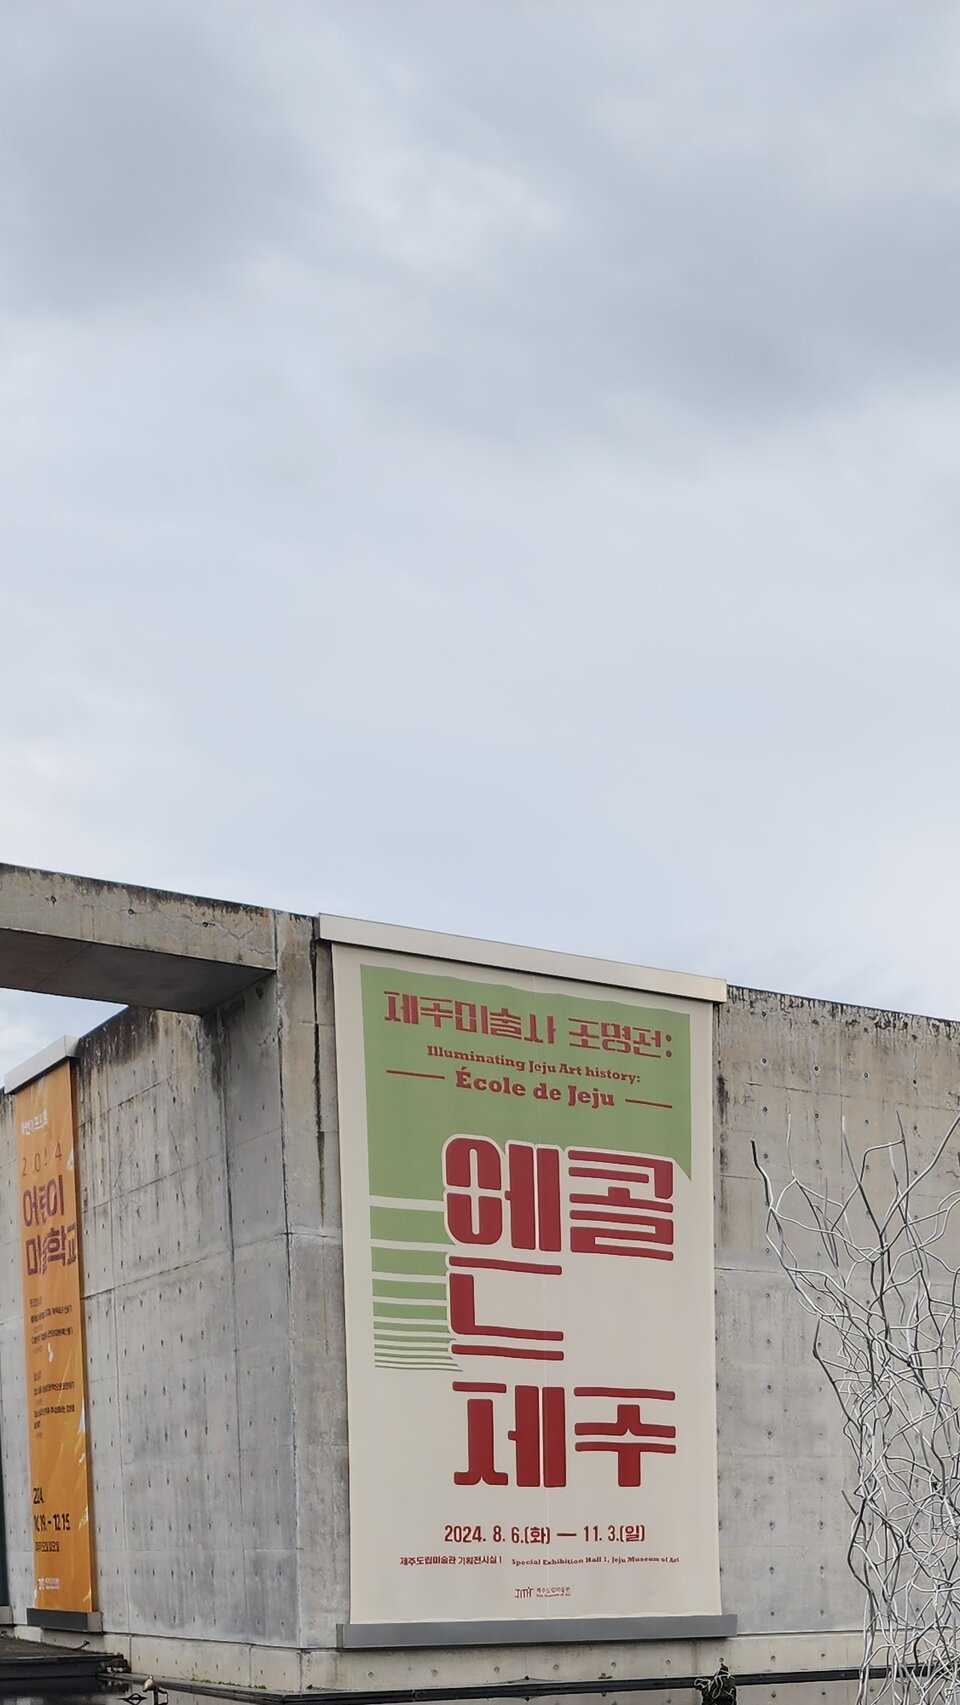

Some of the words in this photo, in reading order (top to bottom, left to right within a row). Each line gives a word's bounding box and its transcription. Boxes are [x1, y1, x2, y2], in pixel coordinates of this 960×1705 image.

[384, 991, 556, 1045] 제주미술사
[568, 1017, 672, 1058] 조명전:
[427, 1045, 525, 1071] Illuminating
[529, 1060, 556, 1075] Jeju
[560, 1063, 582, 1076] Art
[585, 1066, 641, 1085] history:
[456, 1066, 526, 1096] École
[533, 1083, 561, 1101] de
[568, 1085, 615, 1109] Jeju
[445, 1137, 674, 1262] 에콜
[452, 1381, 676, 1488] 제주
[444, 1525, 487, 1543] 2024.
[493, 1525, 506, 1542] 8.
[584, 1525, 602, 1541] 11.
[400, 1555, 456, 1566] 제주도립미술관
[458, 1555, 497, 1565] 기획전시실
[511, 1558, 541, 1567] Special
[543, 1558, 584, 1566] Exhibition
[586, 1556, 602, 1564] Hall
[612, 1555, 626, 1564] Jeju
